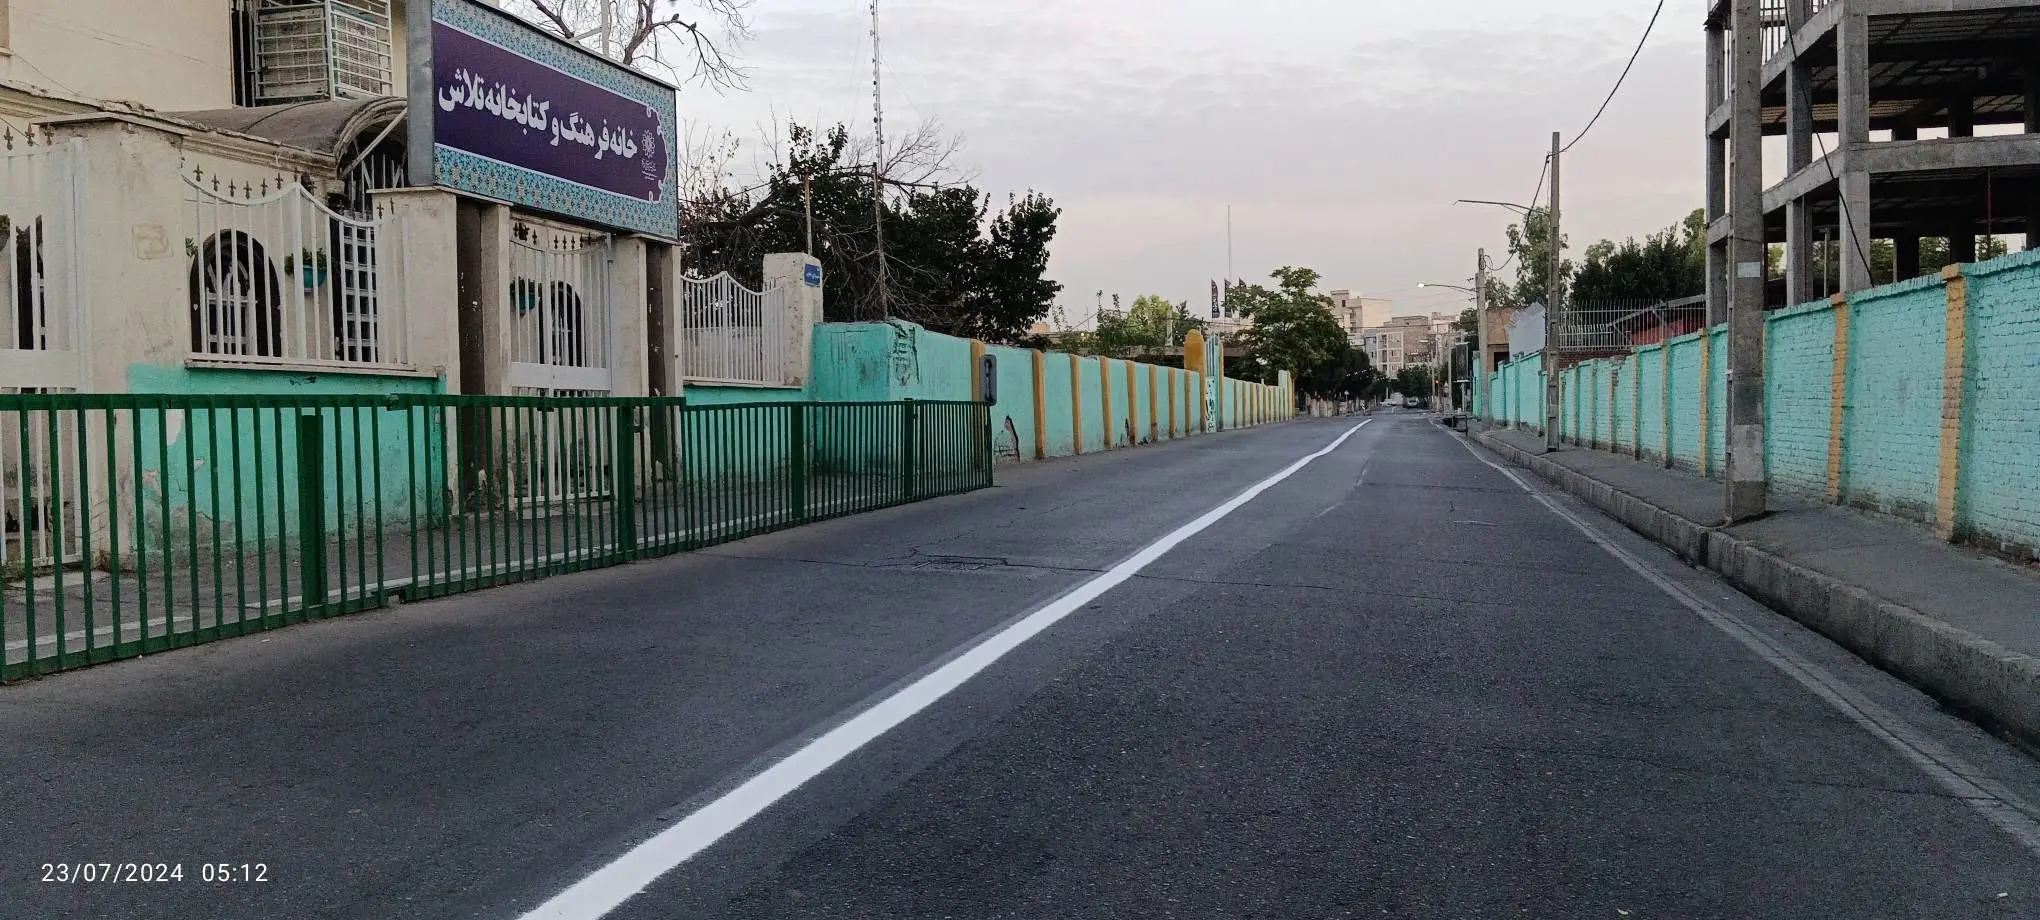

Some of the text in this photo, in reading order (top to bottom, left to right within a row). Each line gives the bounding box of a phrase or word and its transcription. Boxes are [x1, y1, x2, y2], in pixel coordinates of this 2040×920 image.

[438, 68, 638, 160] خانه فرهنگ و کتابخانه تلاش
